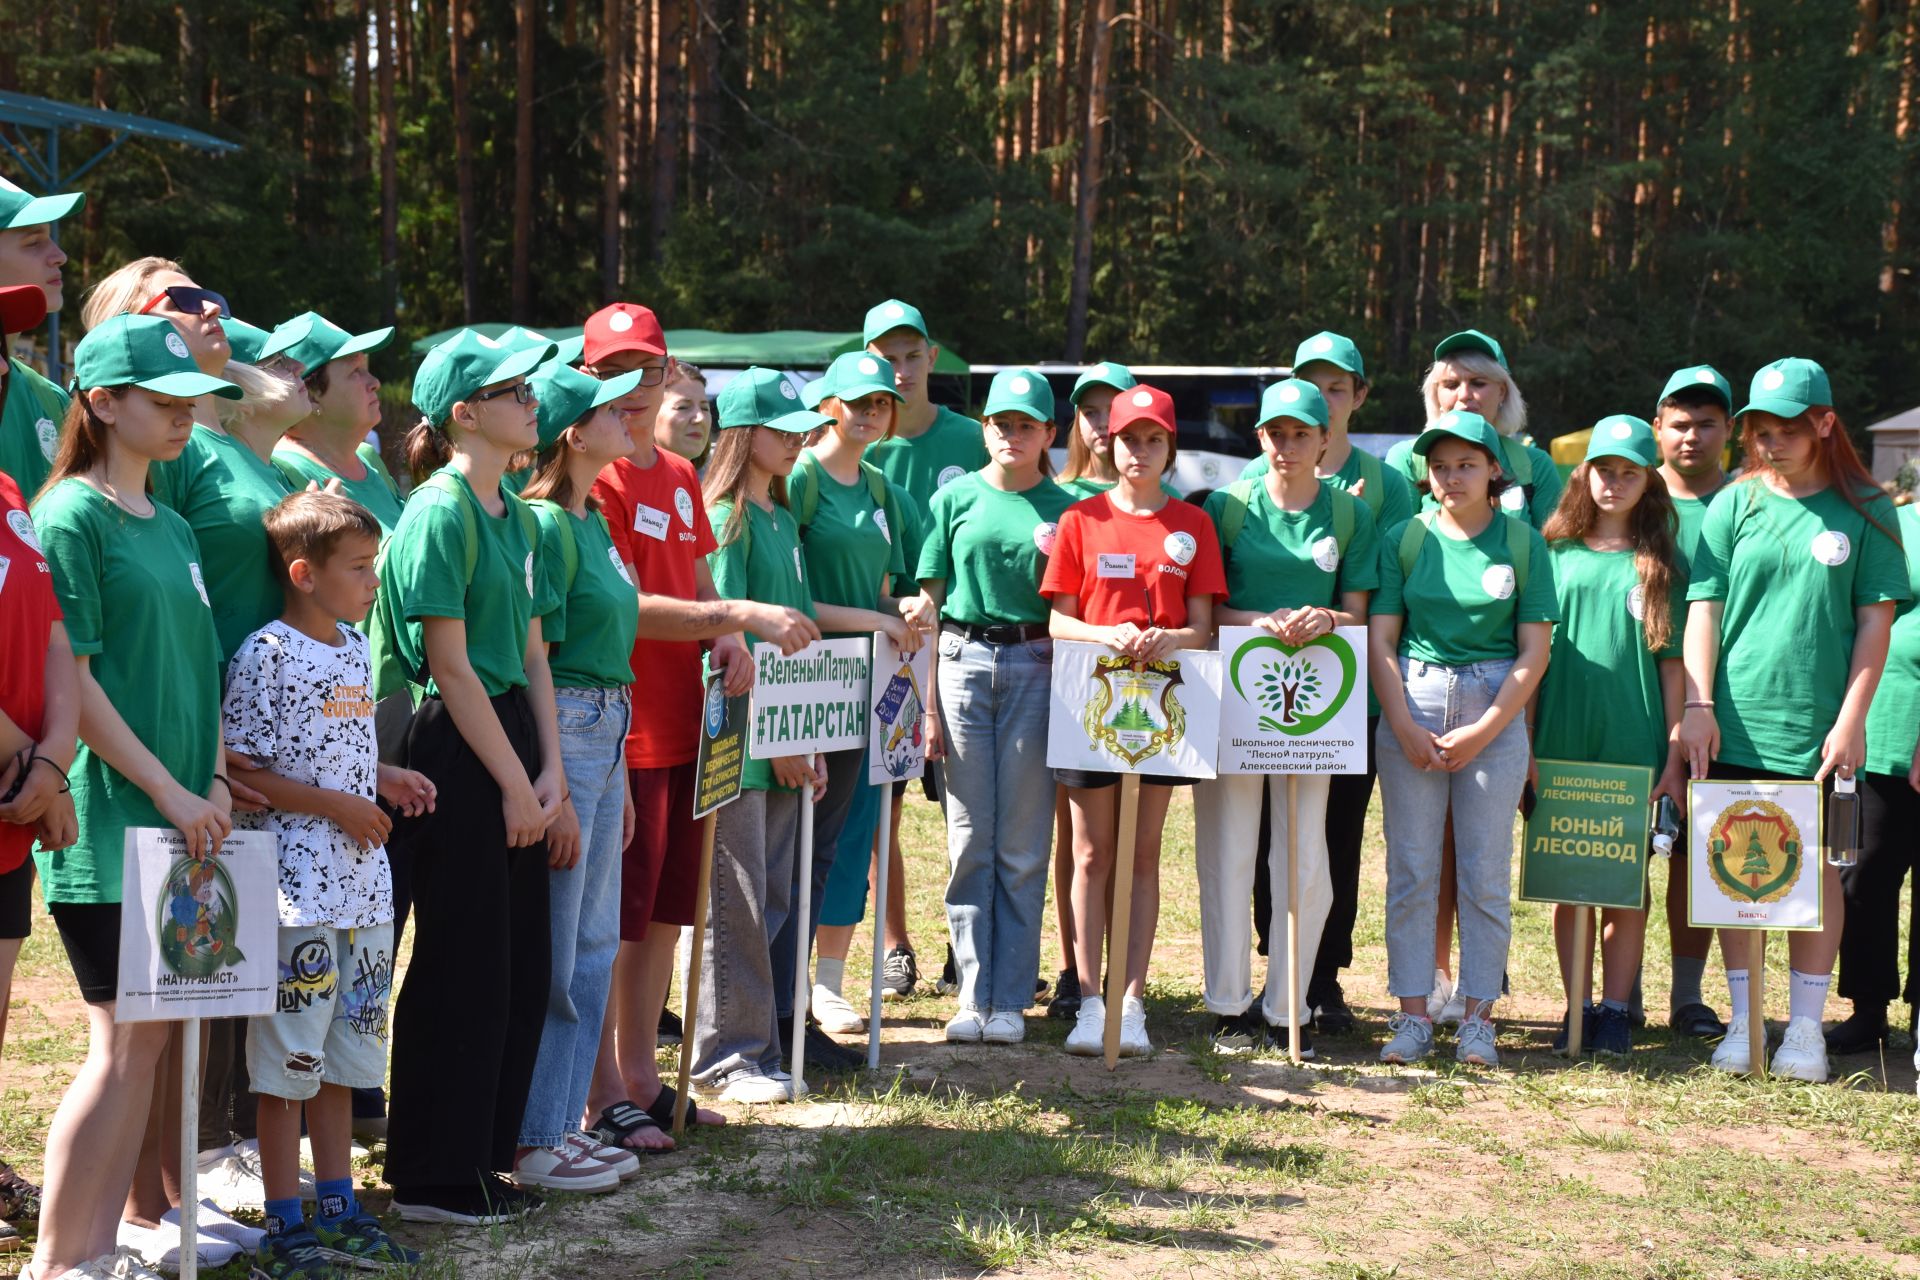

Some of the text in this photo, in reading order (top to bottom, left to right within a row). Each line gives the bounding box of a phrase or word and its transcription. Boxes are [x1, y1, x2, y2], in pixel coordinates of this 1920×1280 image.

[760, 650, 867, 688] #ЗеленыйПатруль
[334, 686, 366, 699] STREET
[323, 700, 374, 718] CULTURE
[757, 701, 866, 745] #ТАТАРСТАН
[1232, 738, 1285, 747] Школьное
[705, 749, 740, 774] ЛЕСНИЧЕСТВО
[1247, 750, 1340, 760] "Лесной патруль"
[1240, 762, 1347, 771] Алексеевский район
[1553, 776, 1627, 791] ШКОЛЬНОЕ
[1542, 789, 1636, 805] ЛЕСНИЧЕСТВО
[1550, 816, 1624, 838] ЮНЫЙ
[1533, 836, 1637, 864] ЛЕСОВОД
[157, 972, 239, 987] «НАТУРАЛИСТ»
